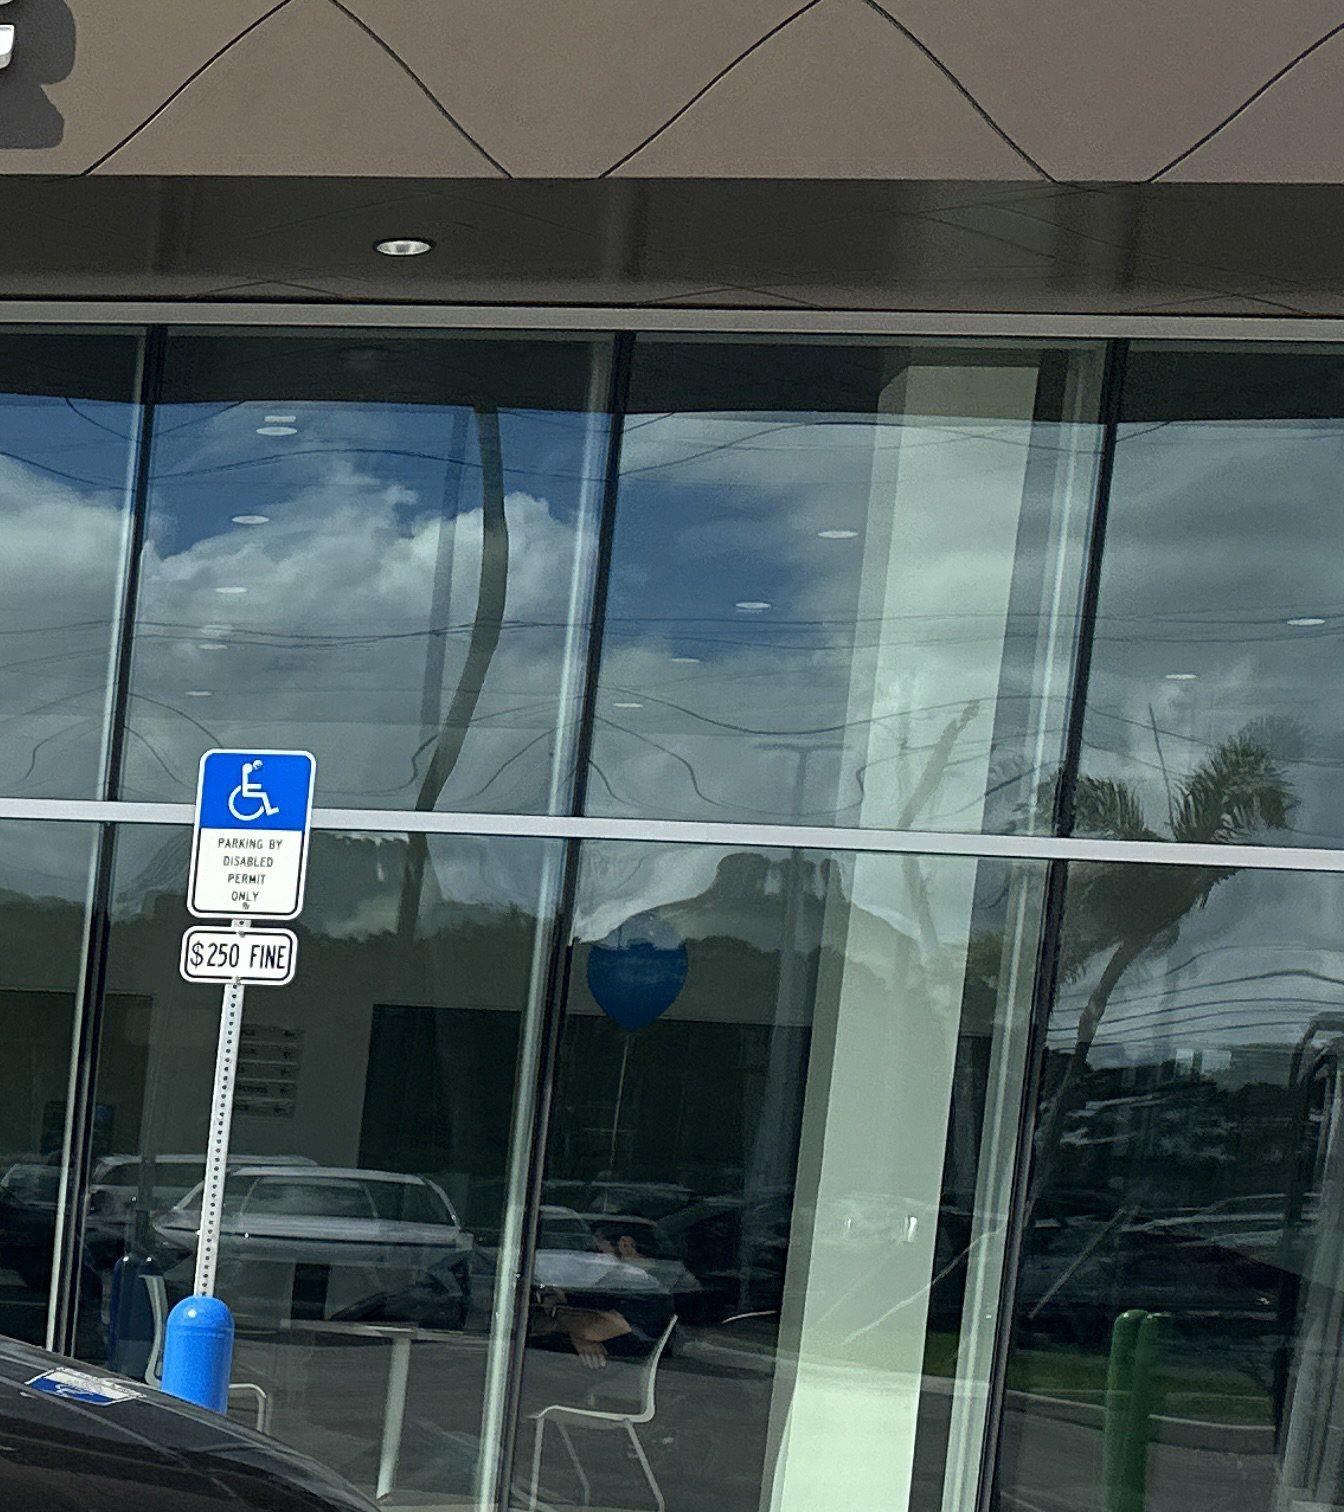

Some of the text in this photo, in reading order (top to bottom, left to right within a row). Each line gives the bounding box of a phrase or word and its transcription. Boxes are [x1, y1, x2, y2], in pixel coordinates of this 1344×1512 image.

[218, 838, 283, 850] PARKING BY
[223, 856, 274, 868] DISABLED
[228, 873, 266, 884] PERMIT
[232, 891, 260, 902] ONLY
[190, 940, 287, 970] $250 FINE
